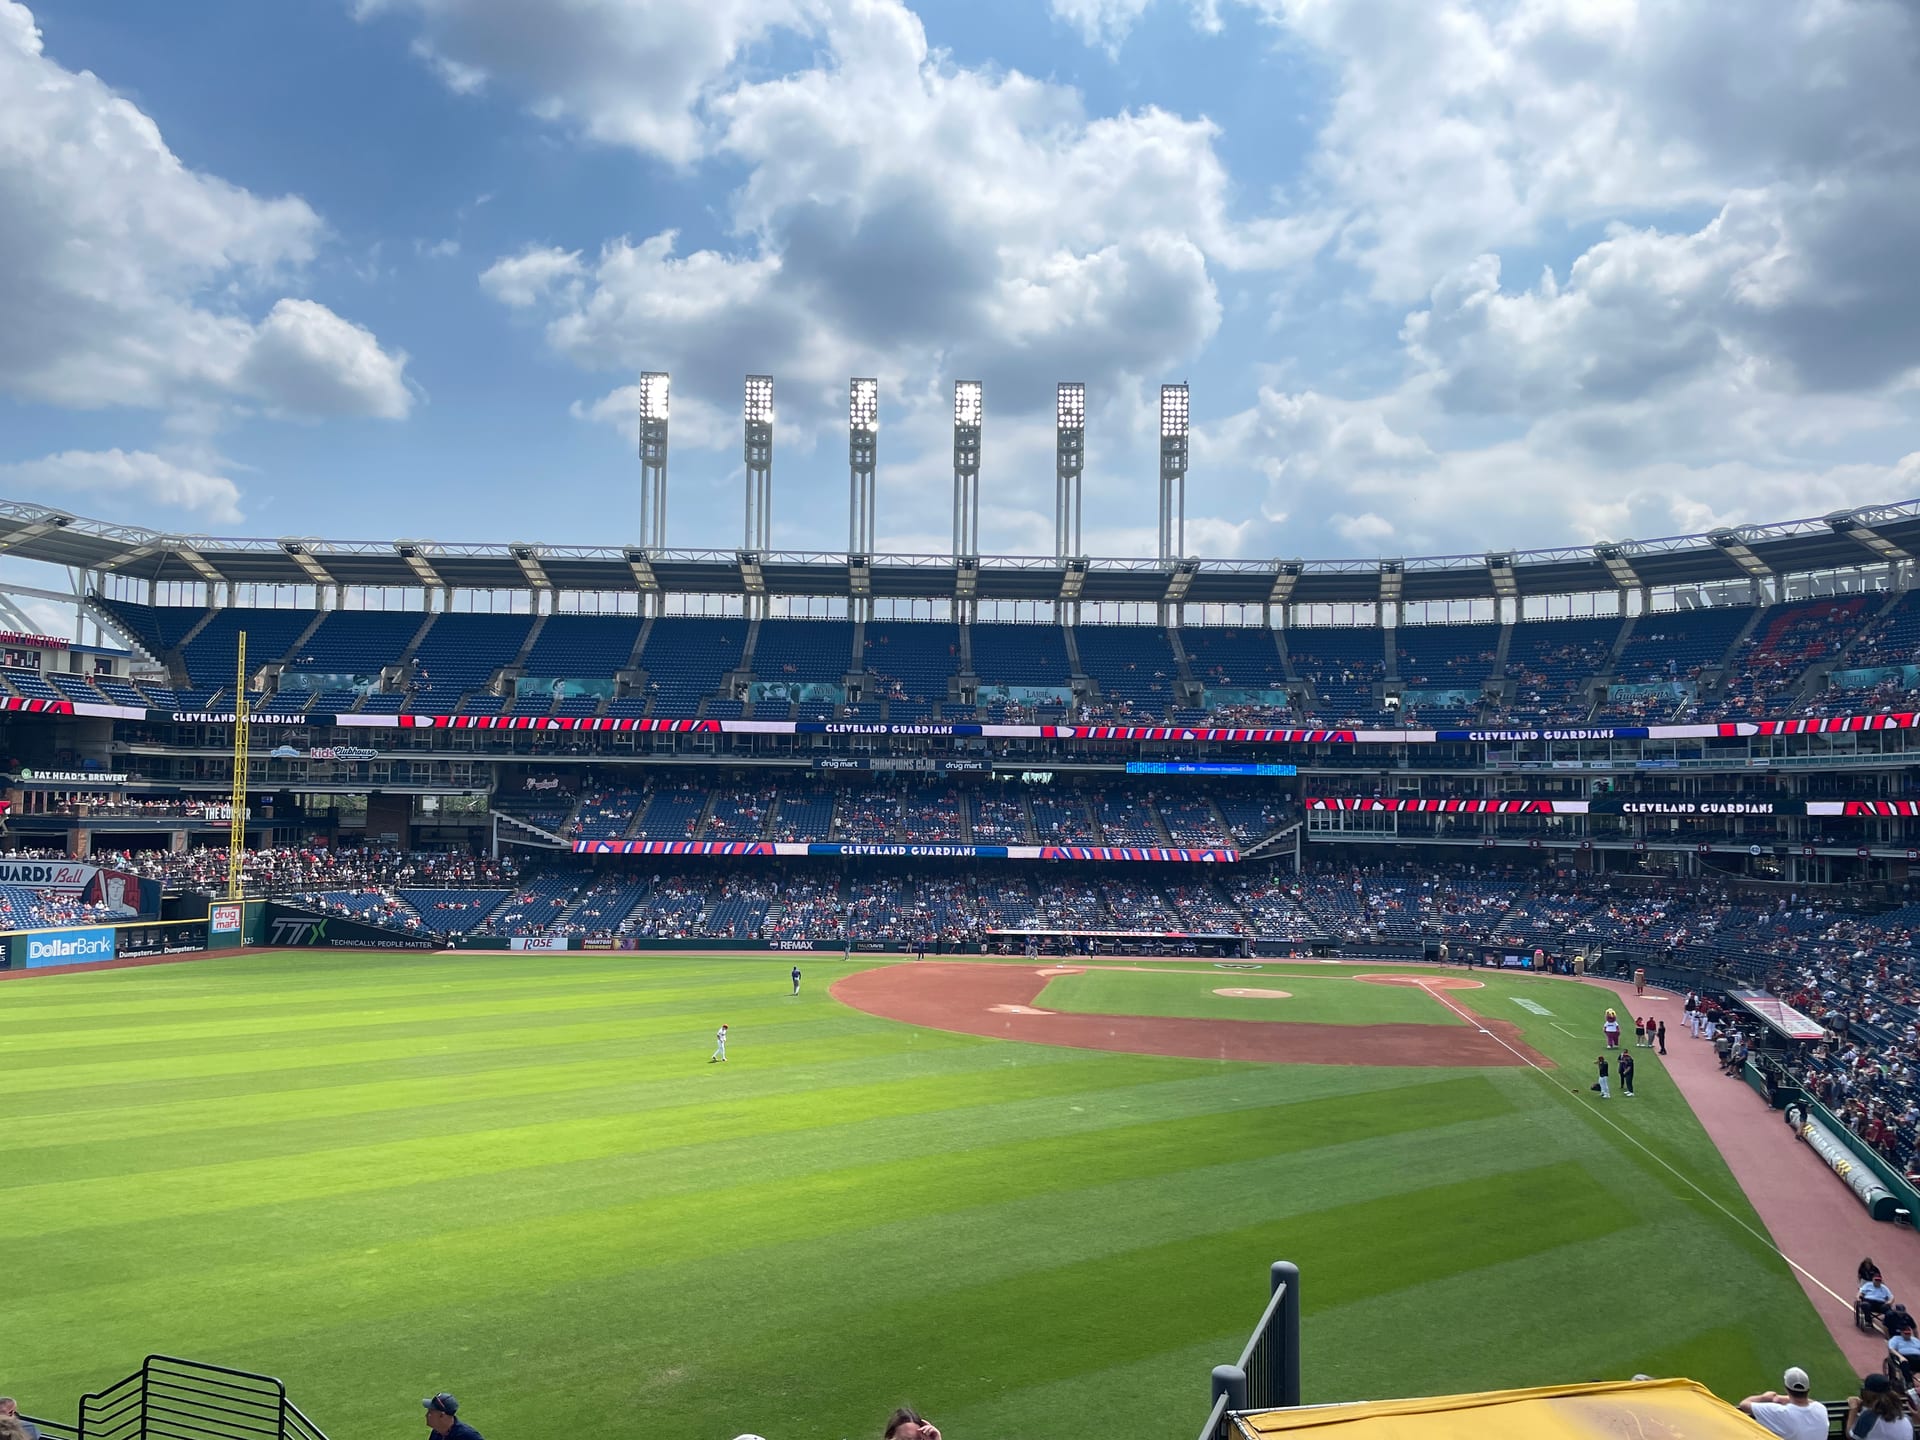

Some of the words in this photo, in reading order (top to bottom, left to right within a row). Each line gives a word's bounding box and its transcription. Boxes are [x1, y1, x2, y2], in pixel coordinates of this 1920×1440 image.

[25, 633, 70, 650] DISTRICT
[172, 712, 236, 723] CLEVELAND
[825, 724, 887, 733] CLEVELAND
[892, 725, 953, 735] GUARDIANS
[1469, 731, 1539, 741] CLEVELAND
[1543, 729, 1614, 740] GUARDIANS
[311, 748, 334, 758] kids
[333, 746, 375, 756] Clubhouse
[821, 760, 839, 769] drug
[840, 760, 858, 768] mart
[870, 758, 914, 770] CHAMPIONS
[916, 759, 936, 771] CLUB
[945, 761, 963, 770] drug
[34, 771, 50, 779] FAT
[52, 772, 86, 781] HEAD'S
[89, 773, 128, 782] BREWERY
[1622, 803, 1695, 813] CLEVELAND
[1700, 803, 1773, 813] GUARDIANS
[205, 808, 219, 820] THE
[840, 845, 906, 855] CLEVELAND
[911, 846, 976, 856] GUARDIANS
[53, 867, 84, 883] Ball
[215, 907, 236, 921] drug
[216, 918, 240, 928] mart
[271, 917, 328, 945] TTX
[377, 940, 404, 948] PEOPLE
[523, 938, 553, 950] ROSE
